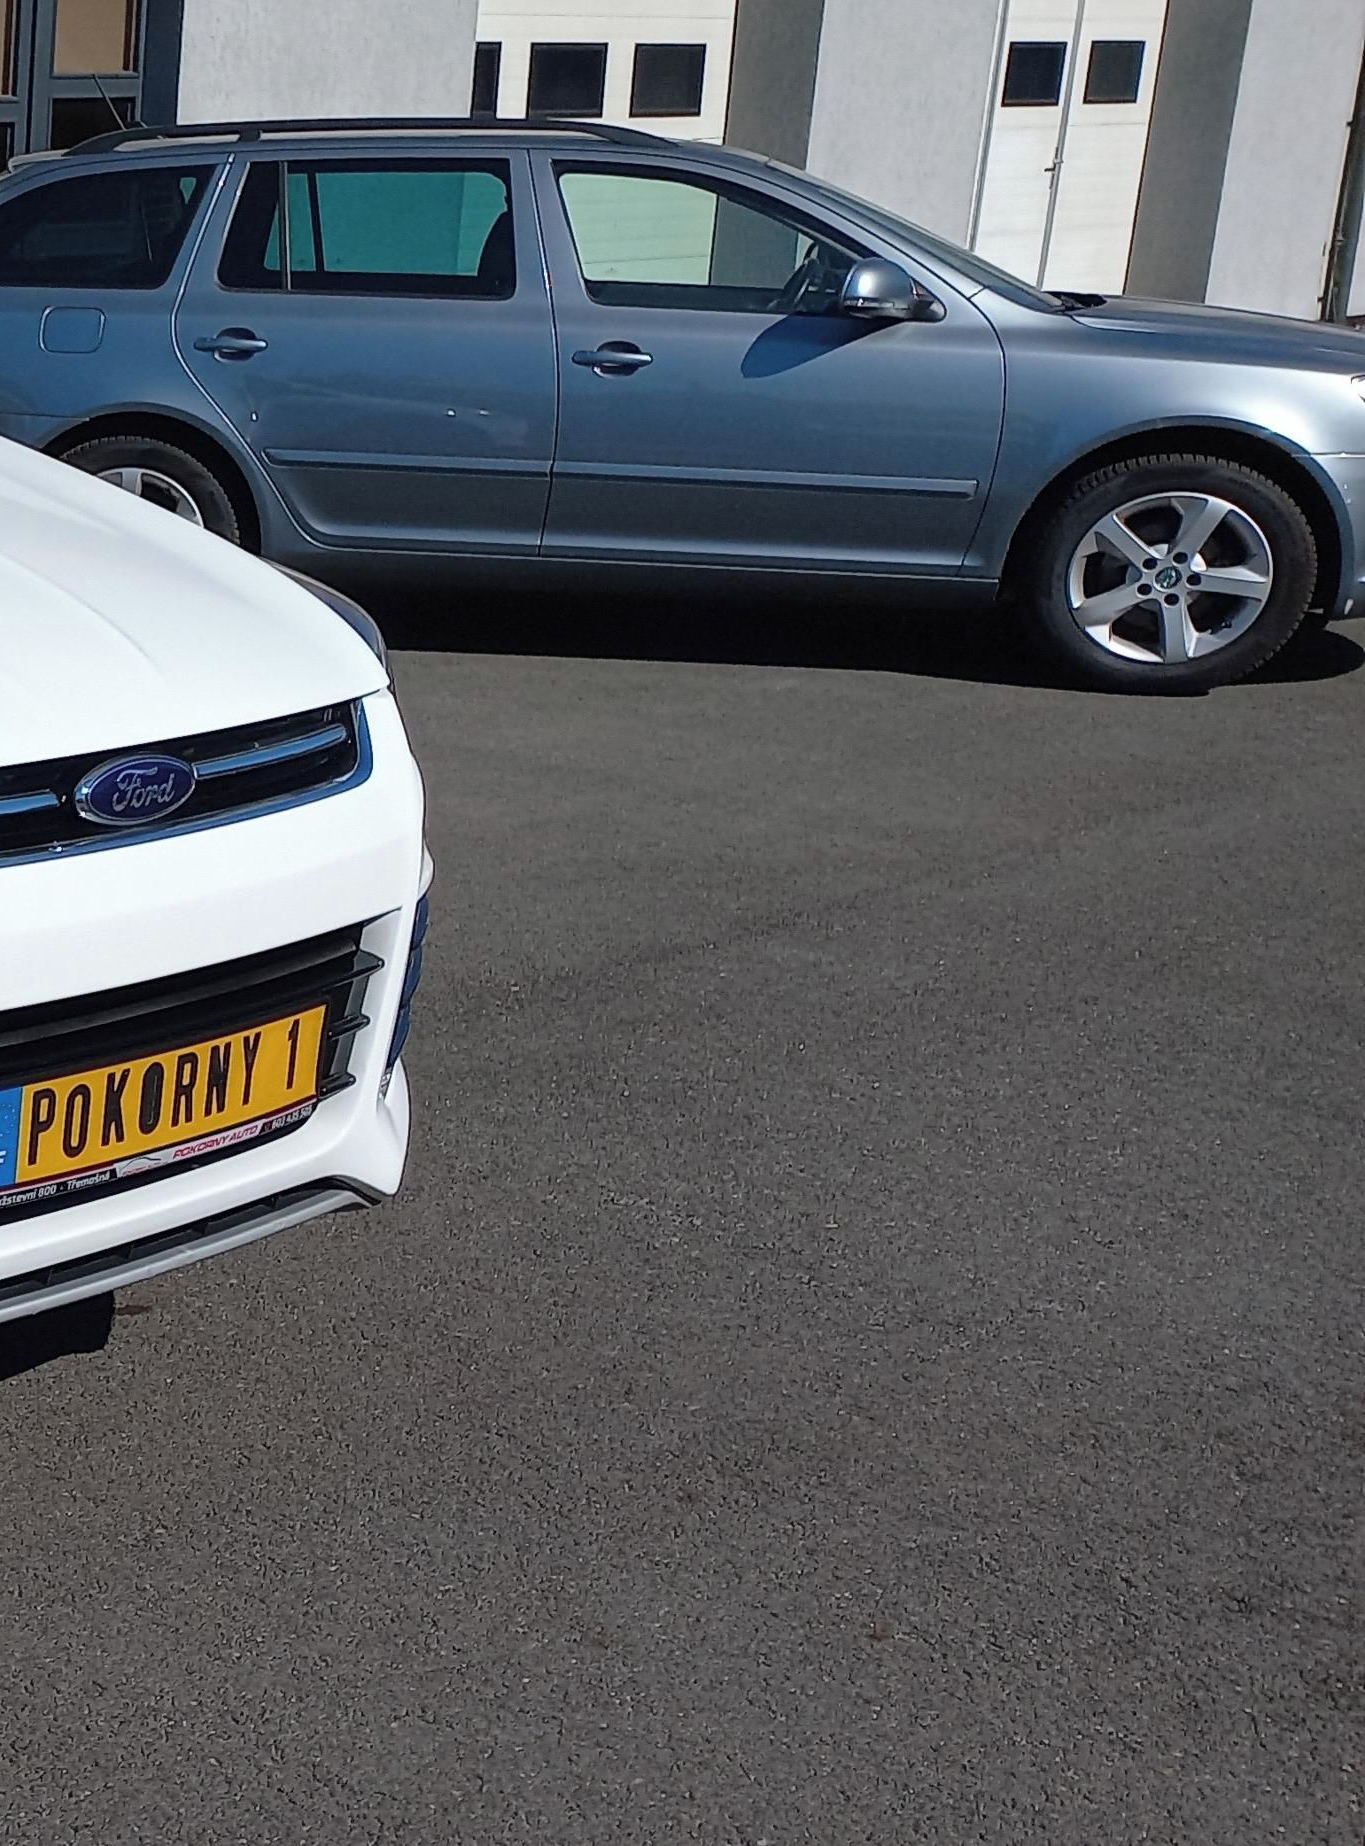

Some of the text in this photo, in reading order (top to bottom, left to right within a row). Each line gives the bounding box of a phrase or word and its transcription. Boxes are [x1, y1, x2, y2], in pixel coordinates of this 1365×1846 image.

[112, 765, 175, 812] Ford
[27, 1018, 300, 1167] POKORNY 1
[173, 1124, 259, 1160] POKORNY AUTO
[38, 1184, 57, 1197] 800
